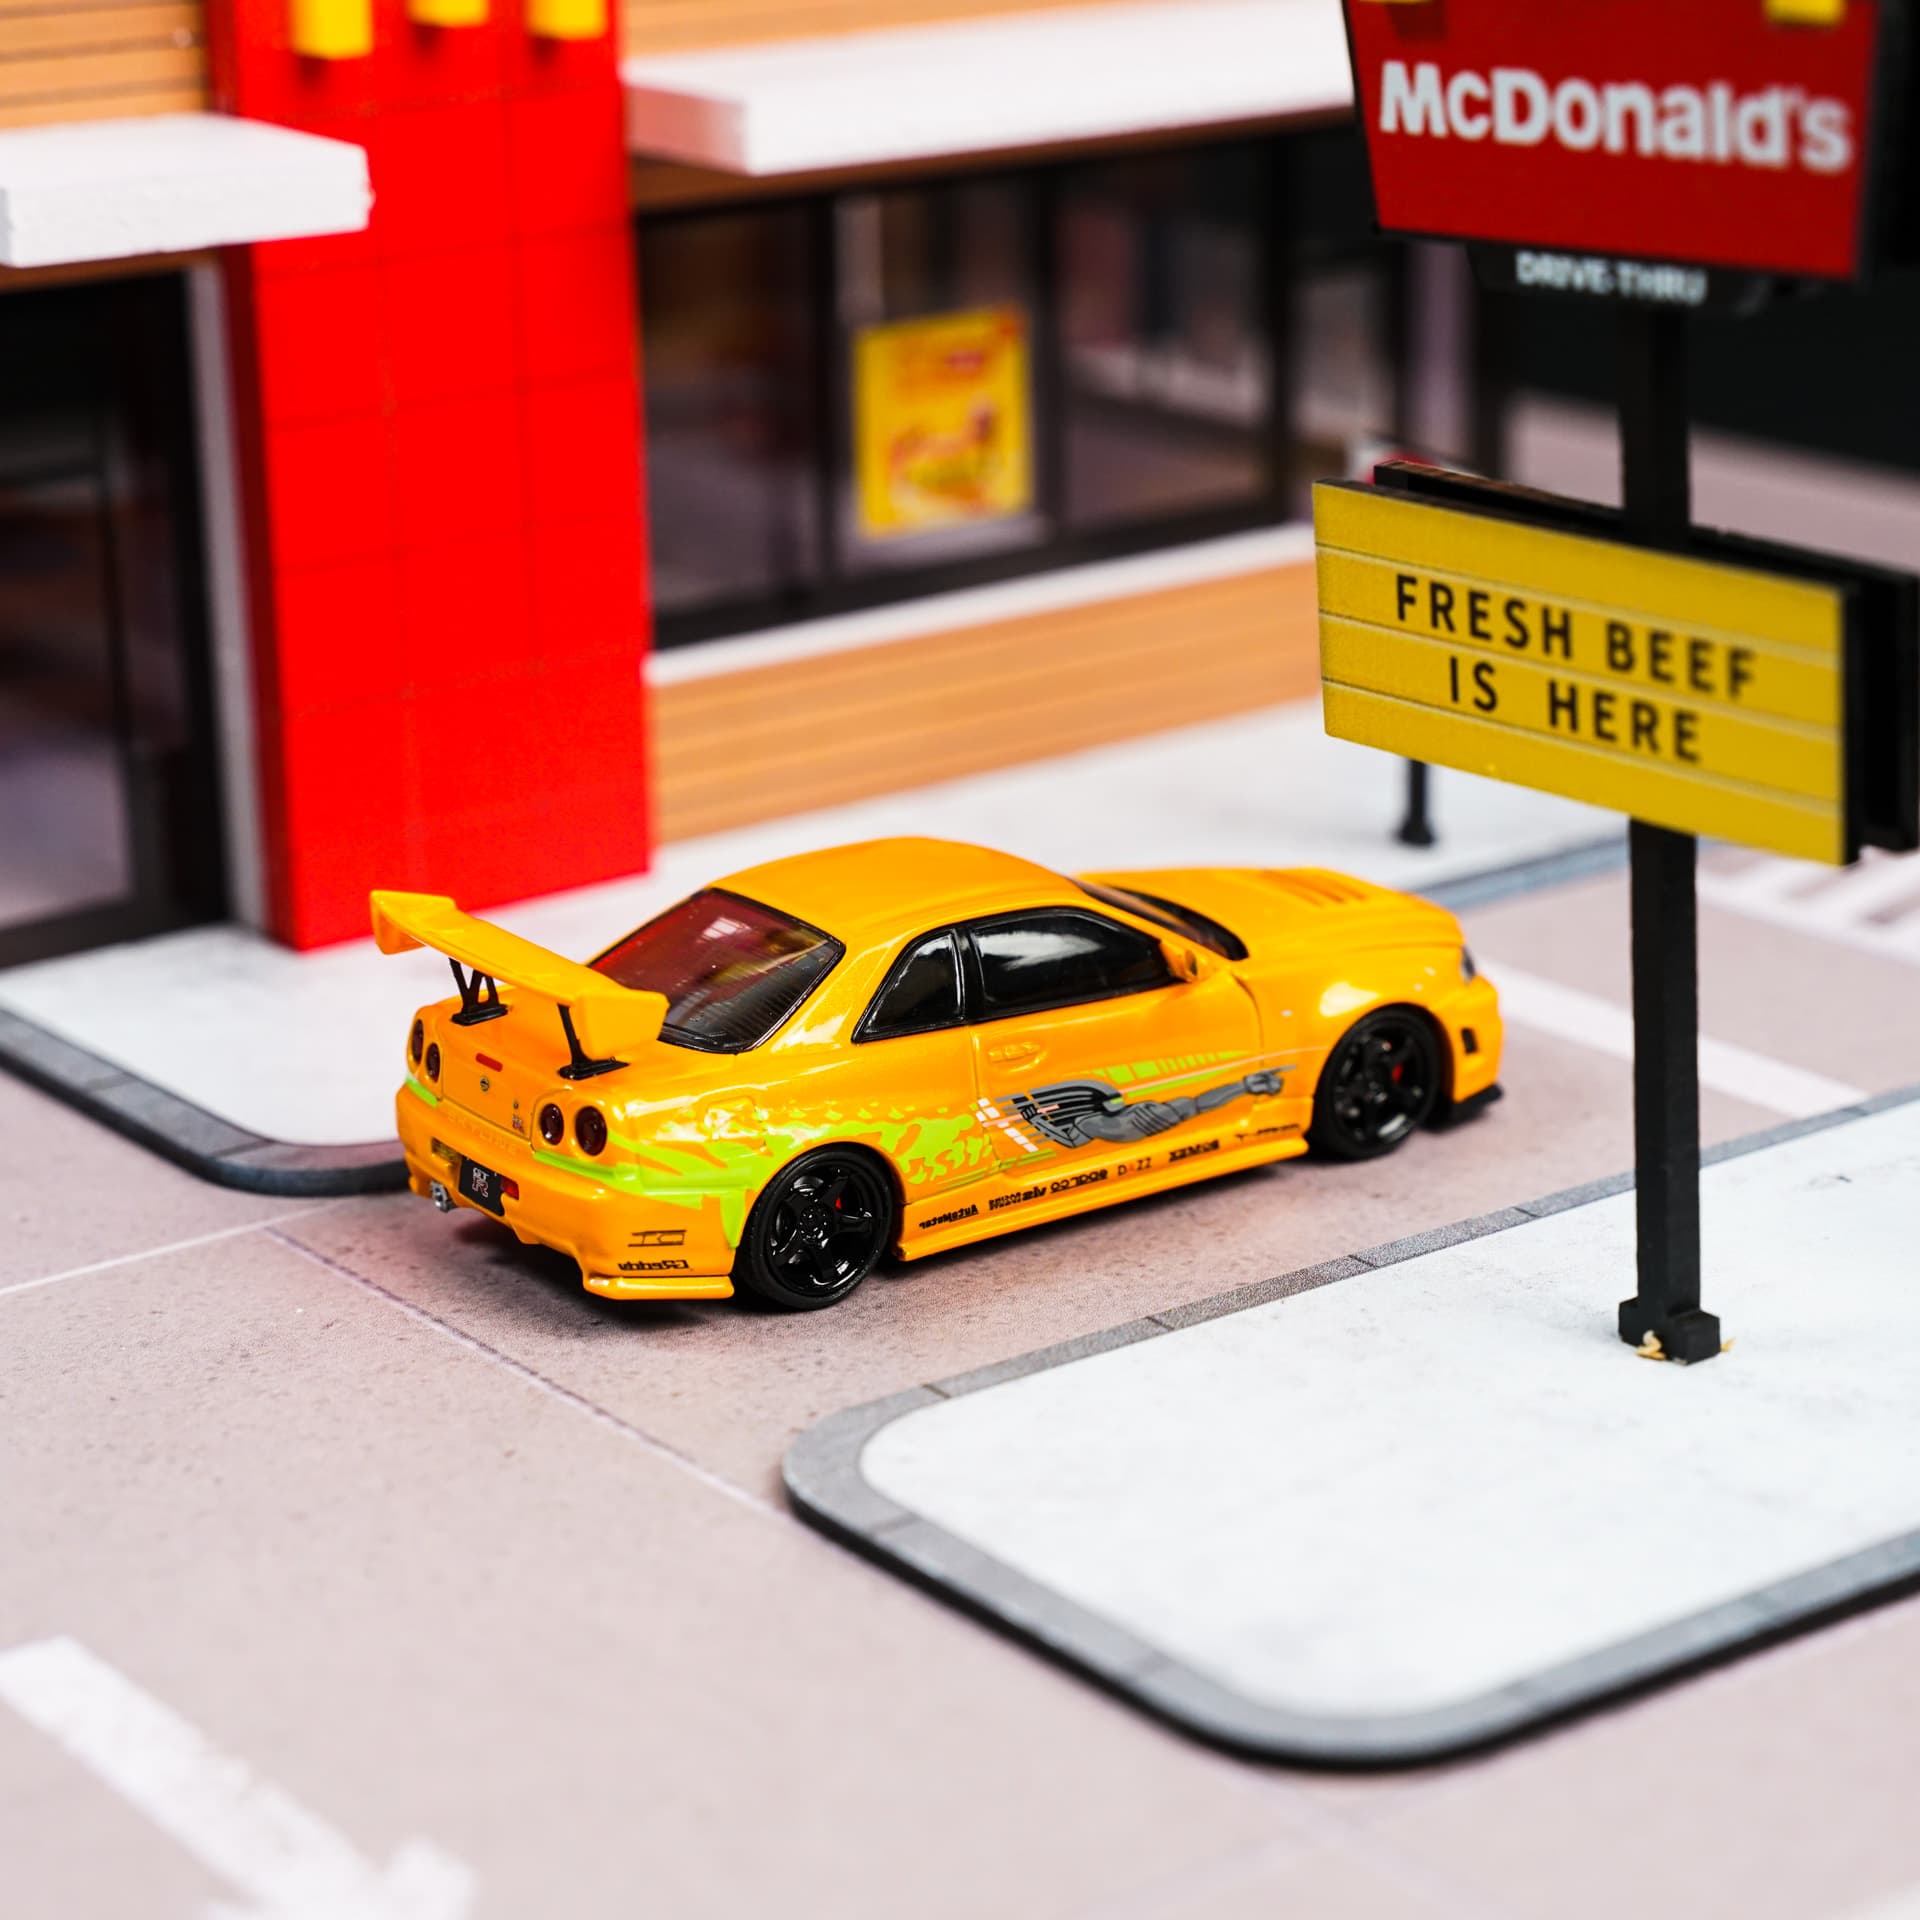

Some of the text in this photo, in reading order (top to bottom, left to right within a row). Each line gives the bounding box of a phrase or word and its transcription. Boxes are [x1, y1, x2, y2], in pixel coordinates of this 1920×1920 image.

[1380, 60, 1853, 173] McDonald's
[1396, 573, 1757, 699] FRESH BEEF
[1449, 656, 1703, 763] IS HERE
